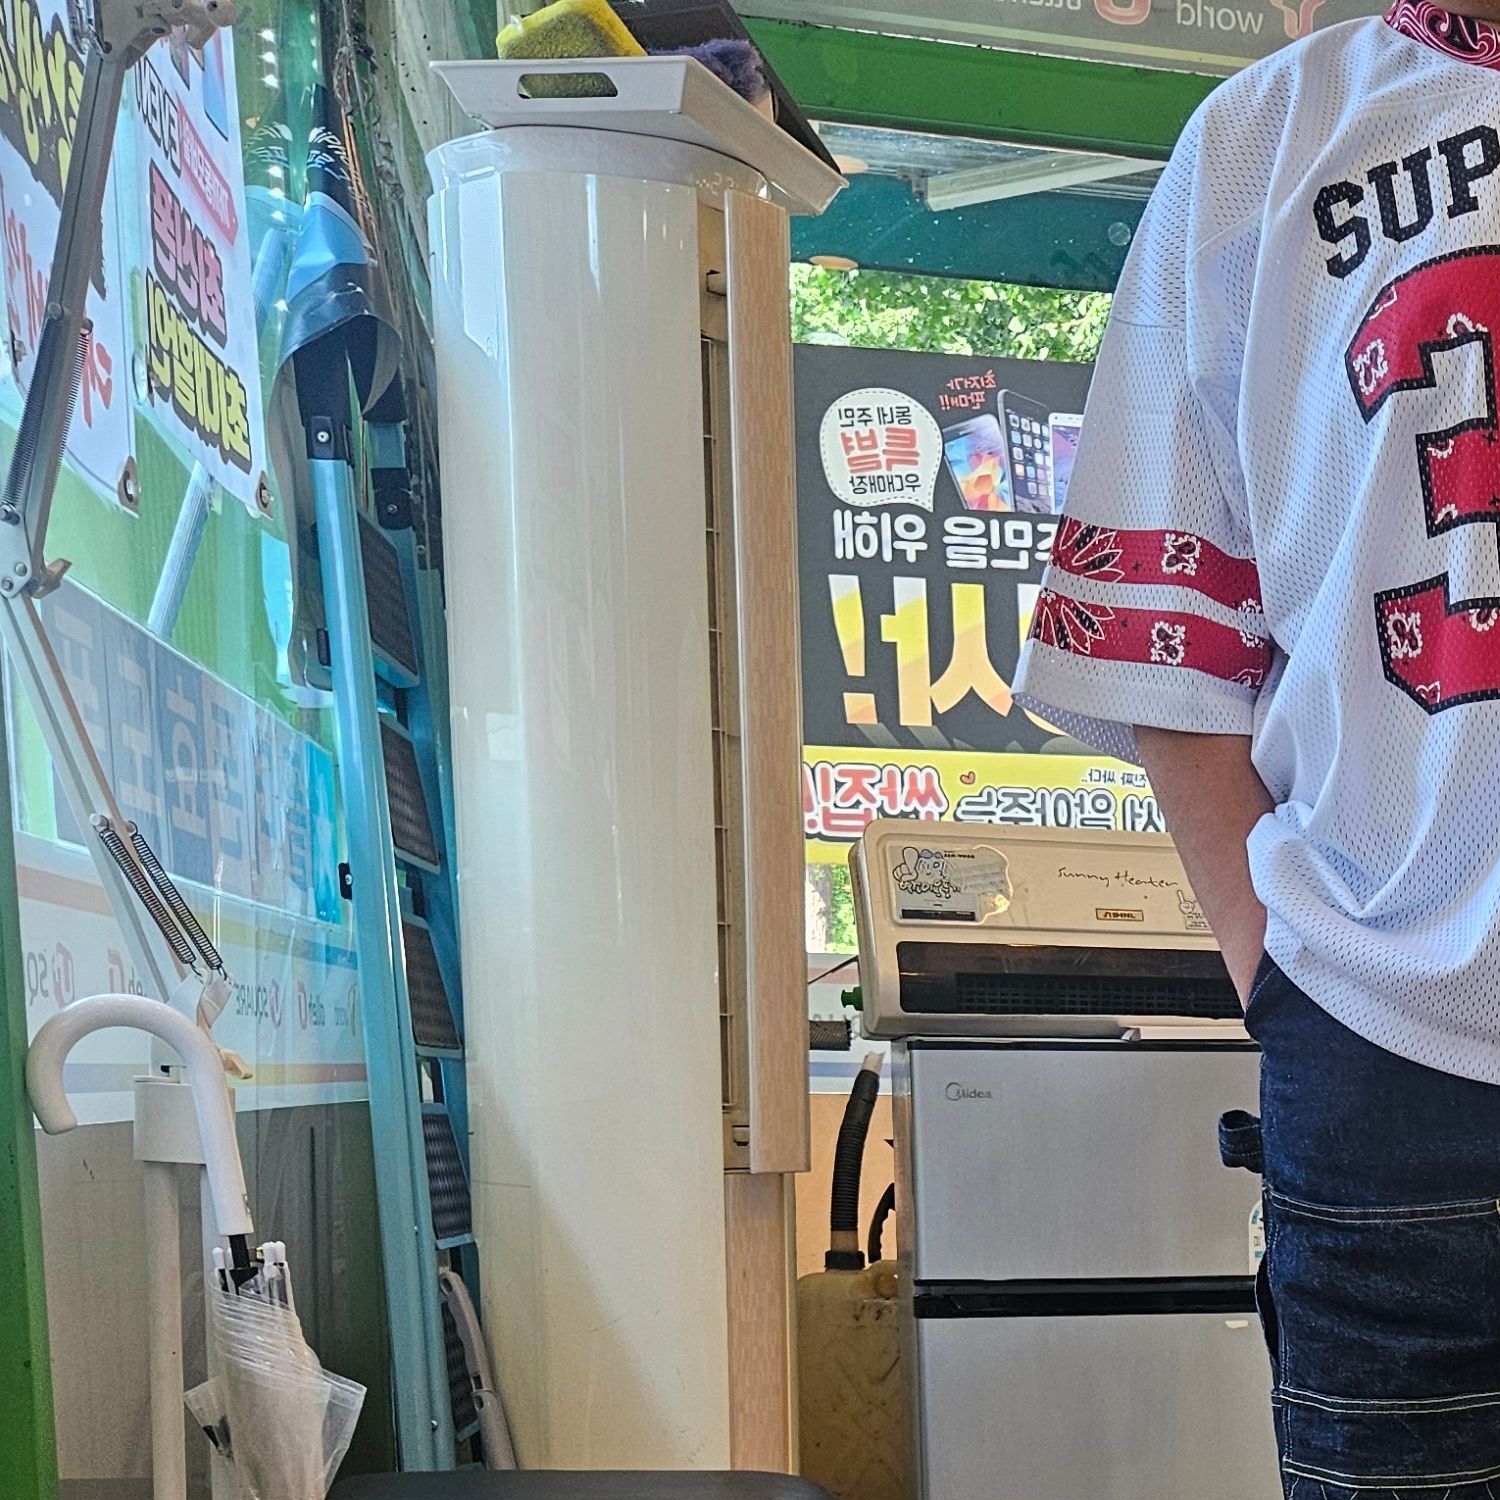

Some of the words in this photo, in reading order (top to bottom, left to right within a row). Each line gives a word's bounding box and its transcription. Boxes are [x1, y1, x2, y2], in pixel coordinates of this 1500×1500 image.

[1058, 866, 1110, 888] Sunny
[1115, 870, 1178, 888] Heater
[945, 1081, 993, 1101] Midea
